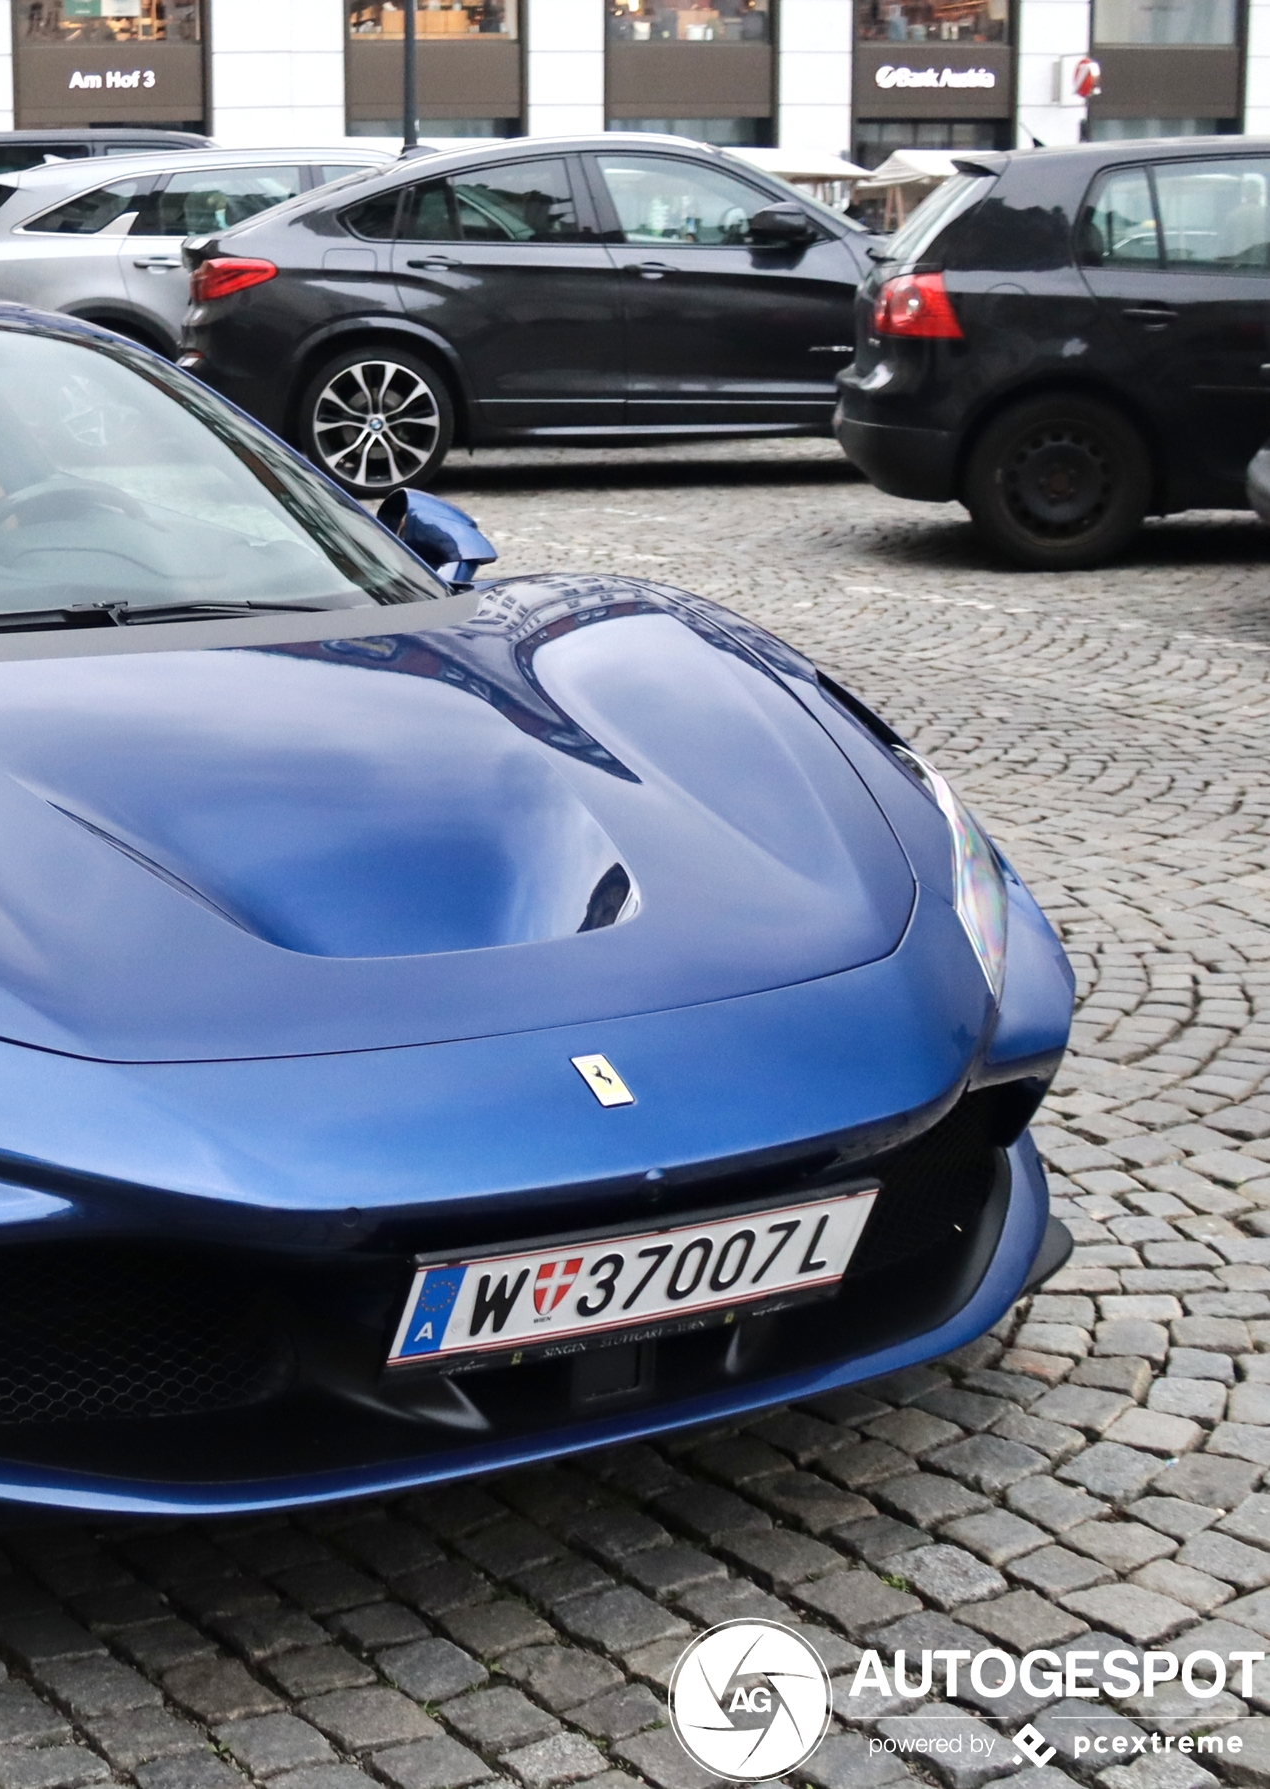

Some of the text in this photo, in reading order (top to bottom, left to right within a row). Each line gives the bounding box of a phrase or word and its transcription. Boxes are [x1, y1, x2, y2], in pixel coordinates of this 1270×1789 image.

[69, 70, 156, 89] Am Hof 3
[896, 67, 995, 88] Bank Austria
[469, 1214, 830, 1337] W 37007L
[414, 1322, 434, 1342] A
